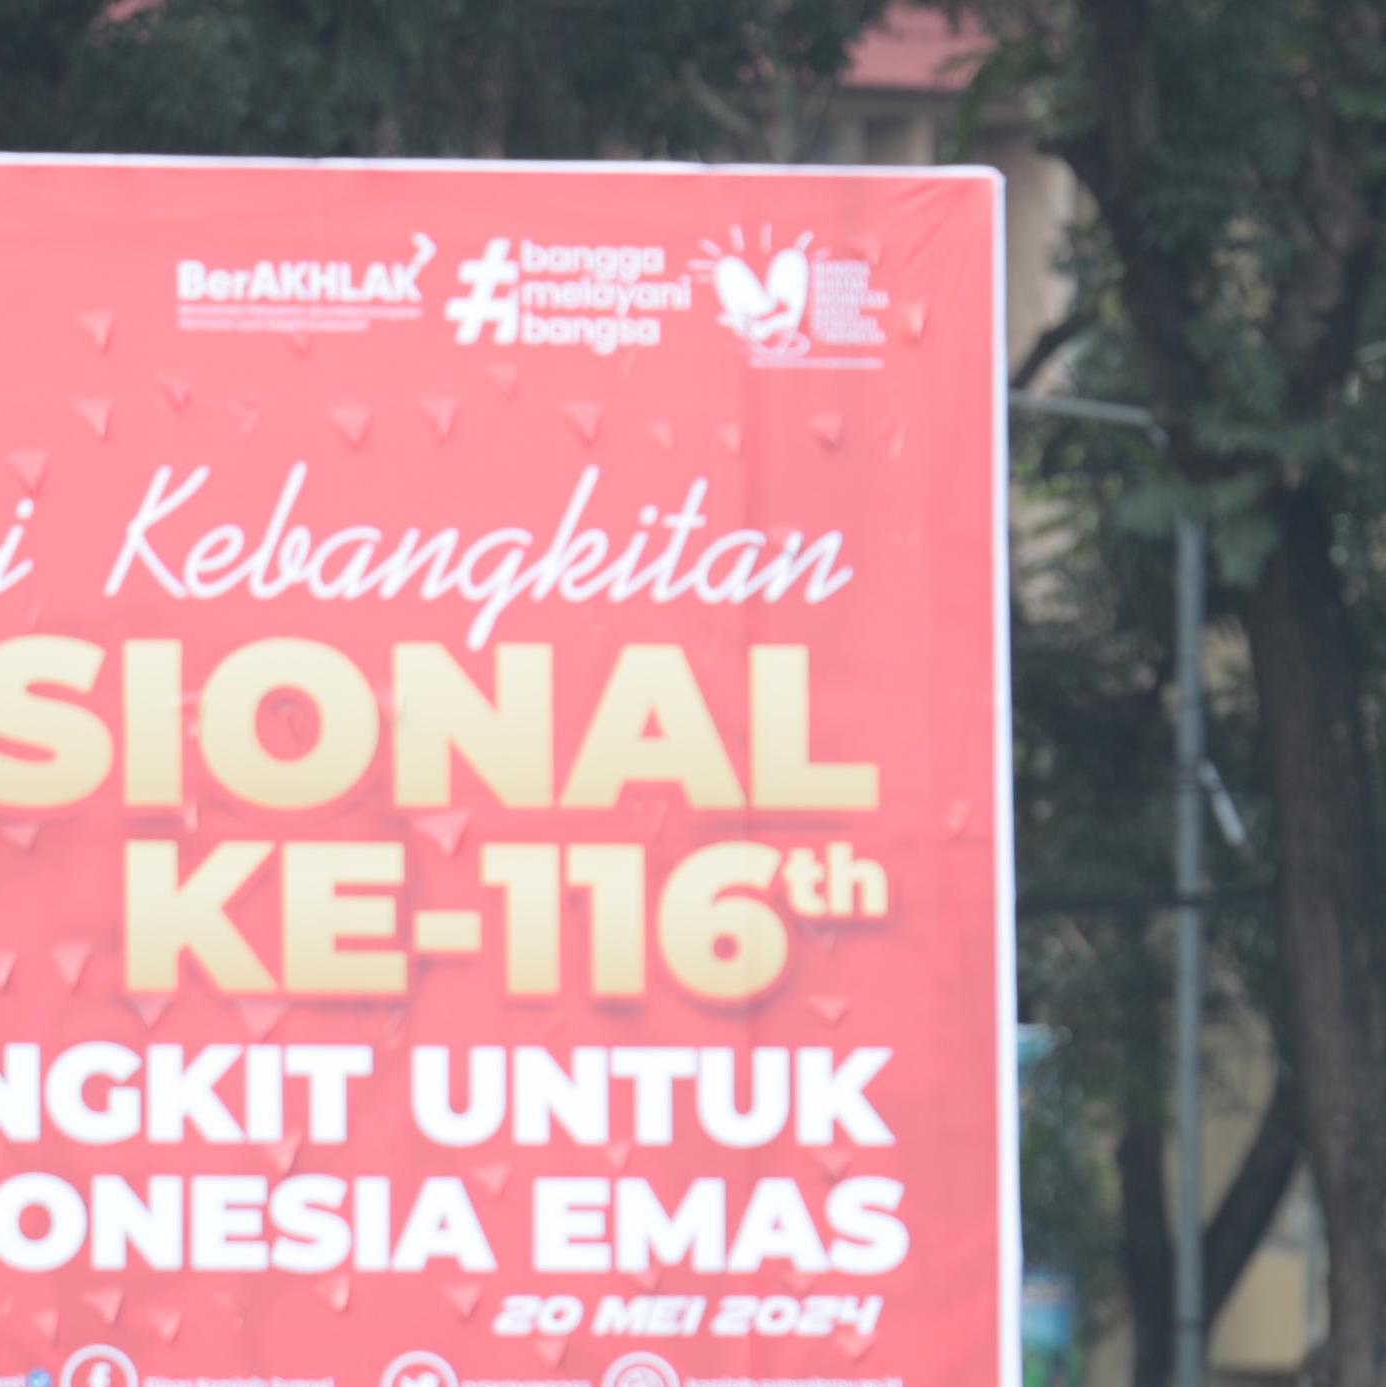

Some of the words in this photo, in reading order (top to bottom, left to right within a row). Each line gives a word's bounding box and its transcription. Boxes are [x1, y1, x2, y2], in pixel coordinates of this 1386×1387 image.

[522, 237, 666, 278] bangga
[175, 259, 425, 302] BerAKHLAK
[521, 276, 693, 312] melayani
[521, 313, 663, 355] bangsa
[104, 461, 854, 656] Kebangkitan
[411, 1045, 895, 1148] UNTUK
[532, 1175, 909, 1275] EMAS
[493, 1295, 584, 1336] 20
[592, 1295, 707, 1336] MEI
[711, 1295, 883, 1337] 2024
